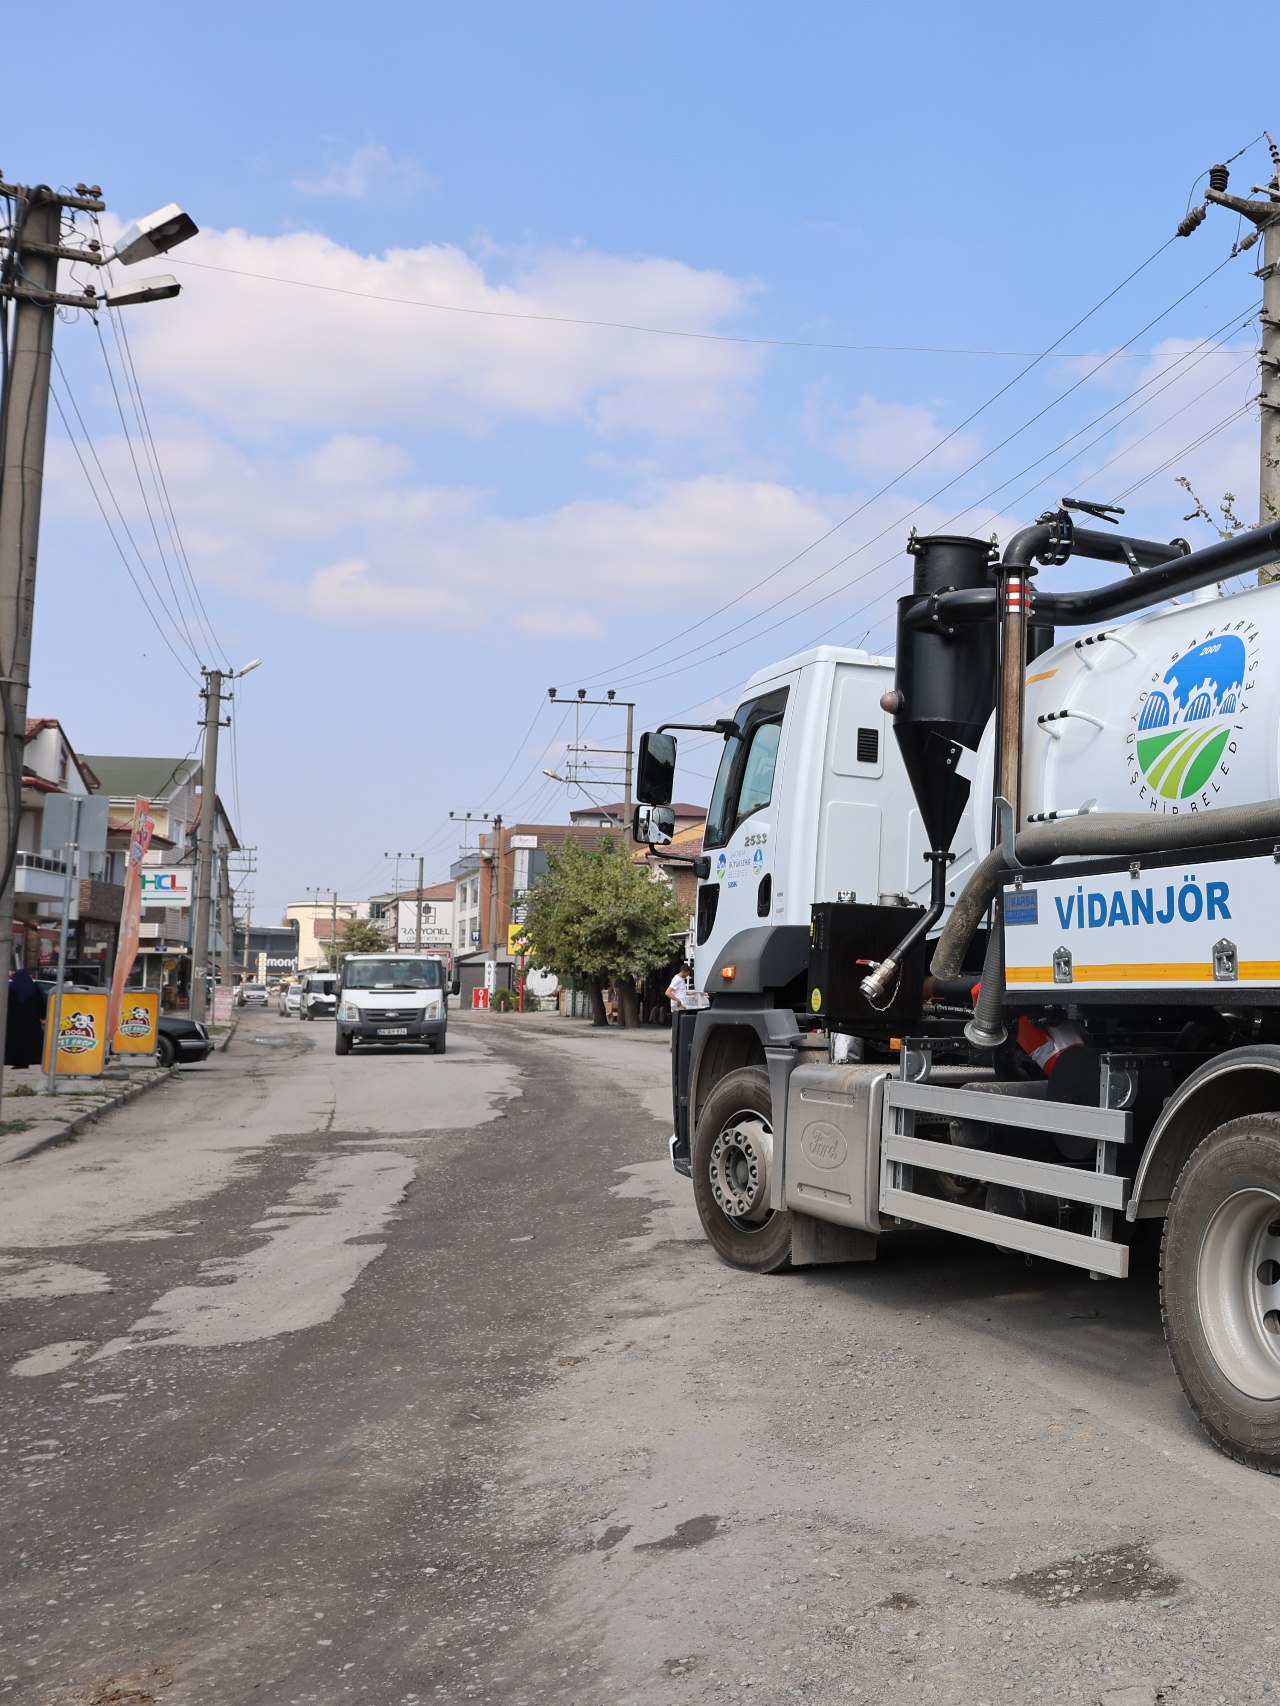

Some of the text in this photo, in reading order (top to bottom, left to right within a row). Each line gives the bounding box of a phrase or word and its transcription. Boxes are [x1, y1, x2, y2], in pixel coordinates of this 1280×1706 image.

[1199, 643, 1222, 656] 2000
[142, 874, 187, 890] HCL
[1054, 874, 1233, 930] VİDANJÖR
[401, 927, 450, 936] RAYONEL
[71, 1038, 94, 1048] SHOP
[810, 1129, 838, 1160] Ford
